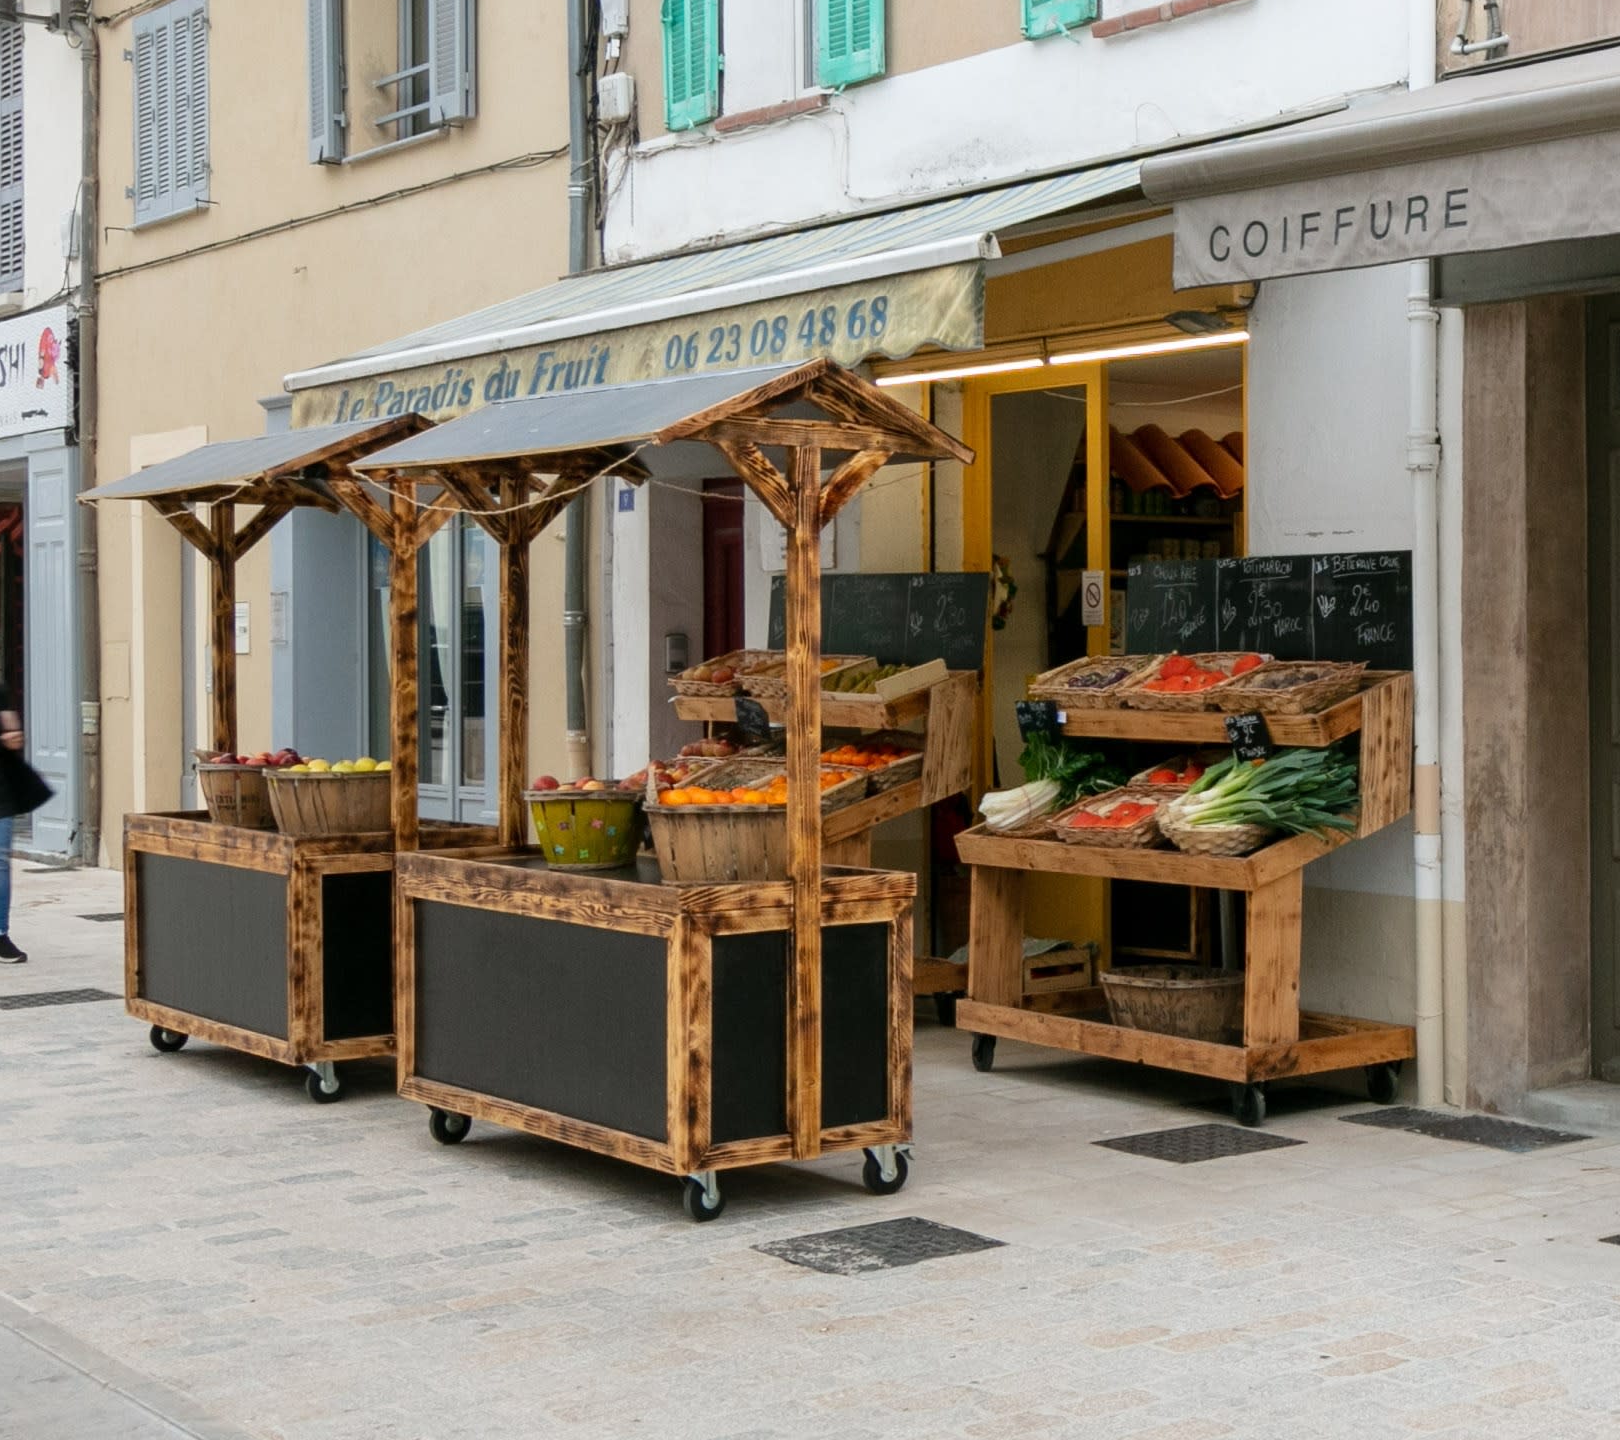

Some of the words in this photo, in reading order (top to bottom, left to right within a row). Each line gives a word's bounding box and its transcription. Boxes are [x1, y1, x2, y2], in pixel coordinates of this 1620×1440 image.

[1209, 188, 1469, 262] COIFFURE
[665, 334, 699, 371] 06
[706, 324, 740, 365] 23
[749, 315, 789, 358] 08
[798, 305, 837, 349] 48
[846, 295, 889, 340] 68
[368, 368, 475, 420] Paradis
[483, 357, 519, 403] du
[529, 345, 612, 395] Fruit
